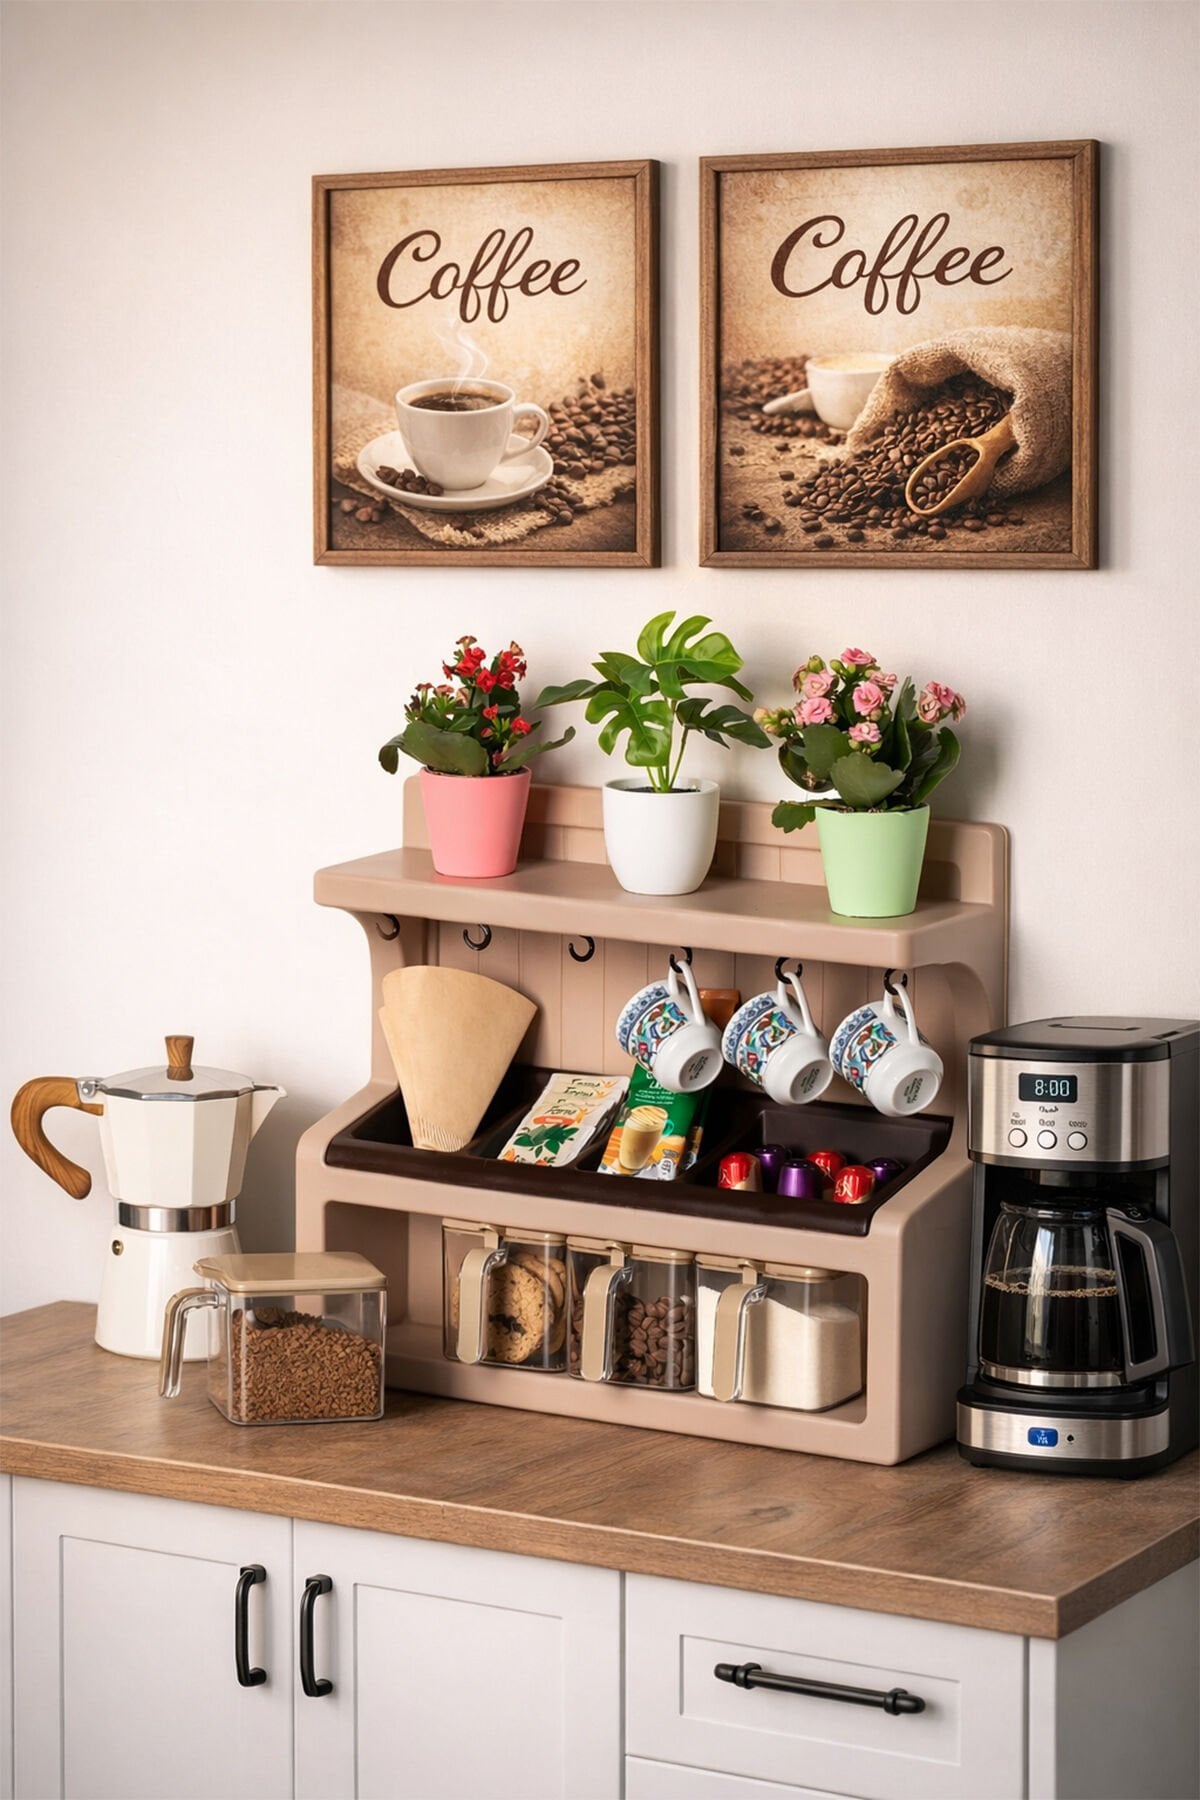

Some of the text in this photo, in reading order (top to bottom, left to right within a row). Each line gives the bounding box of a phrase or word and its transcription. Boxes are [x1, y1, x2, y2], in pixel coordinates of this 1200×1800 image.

[377, 227, 587, 323] Coffee
[771, 212, 1013, 315] Coffee
[1034, 1079, 1070, 1097] 8:00
